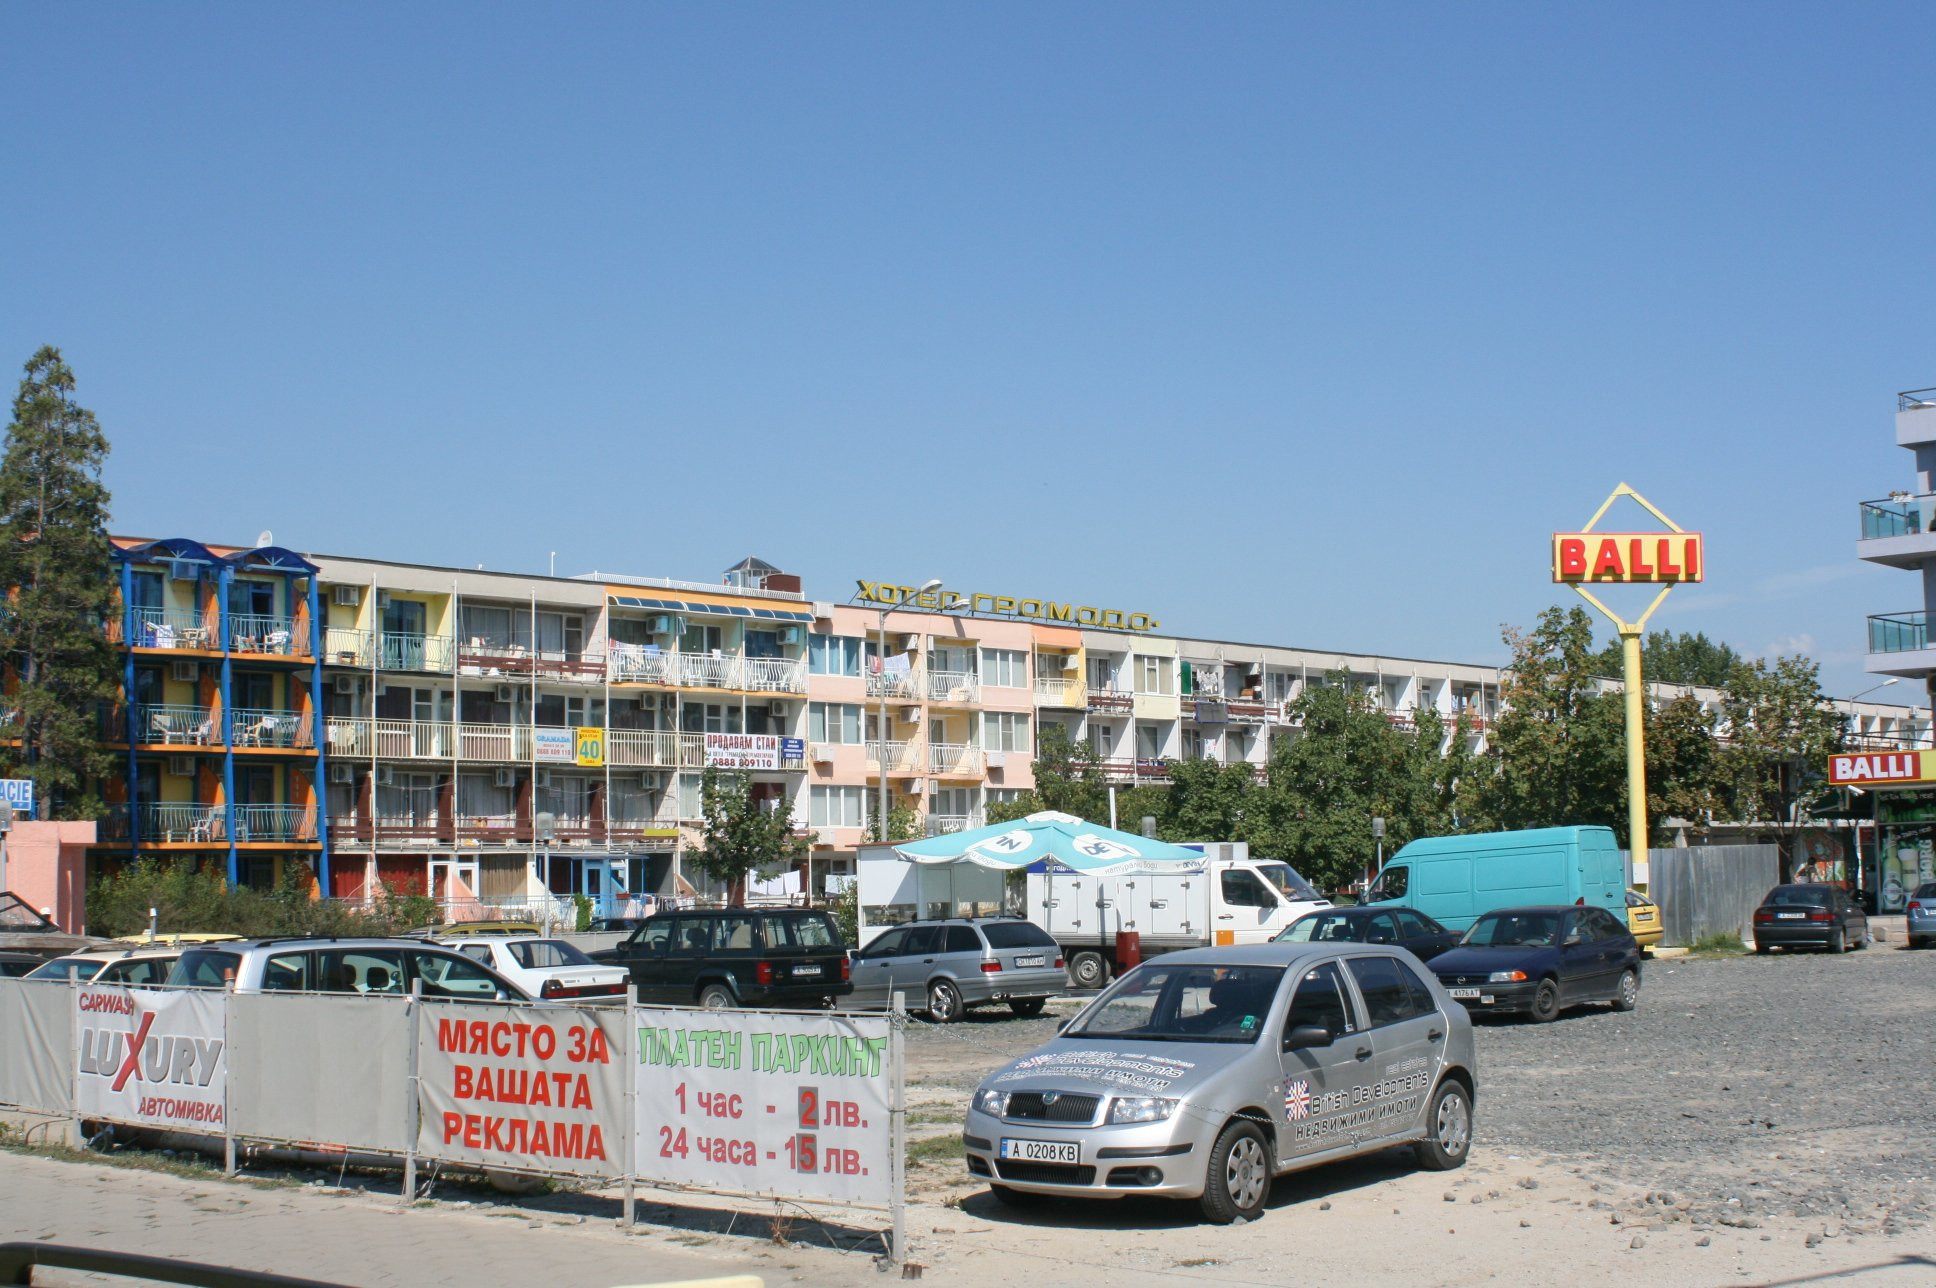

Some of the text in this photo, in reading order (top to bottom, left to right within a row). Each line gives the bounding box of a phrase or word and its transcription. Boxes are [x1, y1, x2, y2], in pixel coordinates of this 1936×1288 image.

[1560, 538, 1698, 578] BALLI
[580, 740, 600, 760] 40
[707, 734, 753, 751] ПРОДАВАМ
[712, 758, 772, 768] 0888 809110
[1835, 754, 1913, 780] BALLI
[79, 1011, 224, 1092] LUXURY
[438, 1018, 610, 1064] МЯСТО ЗА
[638, 1027, 887, 1078] ПЛАТЕН ПАРКИНГ
[454, 1065, 593, 1110] ВАШАТА
[675, 1083, 686, 1114] 1
[697, 1092, 743, 1119] час
[800, 1090, 817, 1126] 2
[824, 1100, 868, 1128] лв.
[1312, 1070, 1428, 1116] British Developments
[137, 1097, 223, 1124] АВТОМИВКА
[1295, 1107, 1376, 1141] НЕДВИЖИМИ
[1379, 1096, 1417, 1119] ИМОТИ
[443, 1111, 607, 1161] РЕКЛАМА
[659, 1126, 689, 1159] 24
[697, 1136, 757, 1166] часа
[784, 1135, 817, 1170] 15
[824, 1148, 868, 1175] лв.
